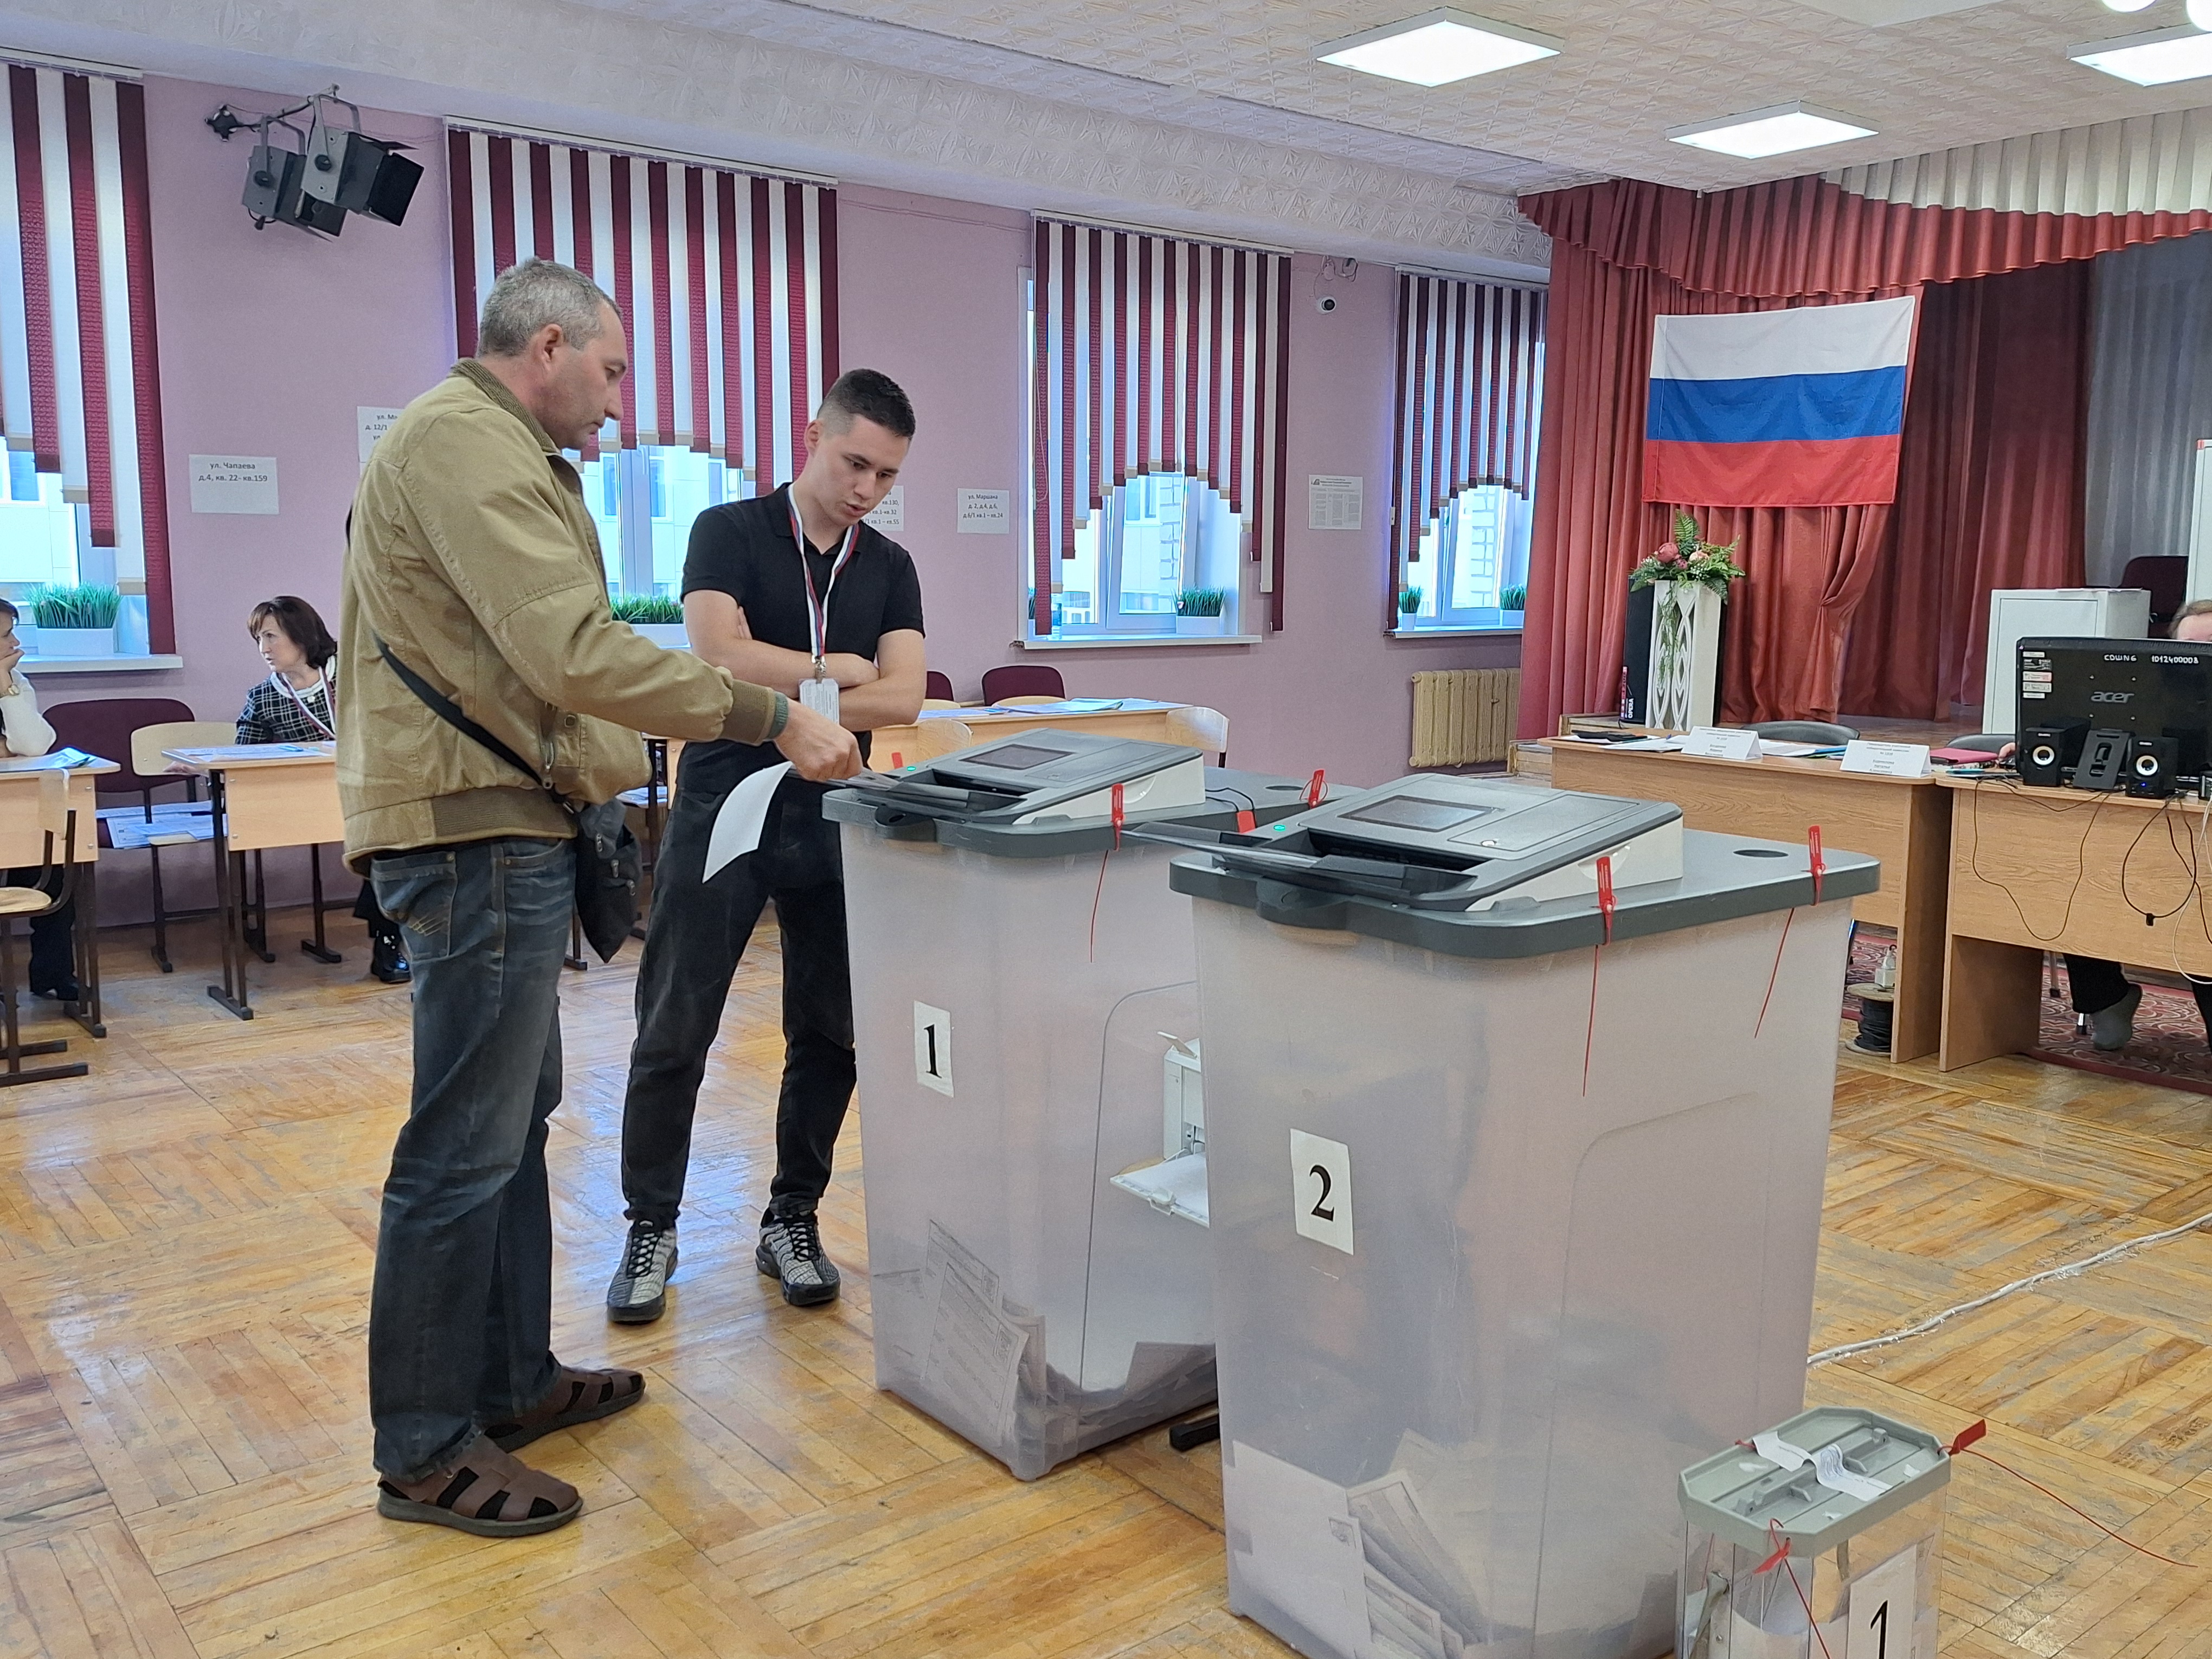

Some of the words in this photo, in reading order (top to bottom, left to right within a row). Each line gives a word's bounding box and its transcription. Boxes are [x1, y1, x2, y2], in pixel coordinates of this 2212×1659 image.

[2091, 691, 2135, 703] acer
[923, 1024, 942, 1078] 1
[1309, 1164, 1335, 1221] 2
[1870, 1599, 1888, 1659] 1
